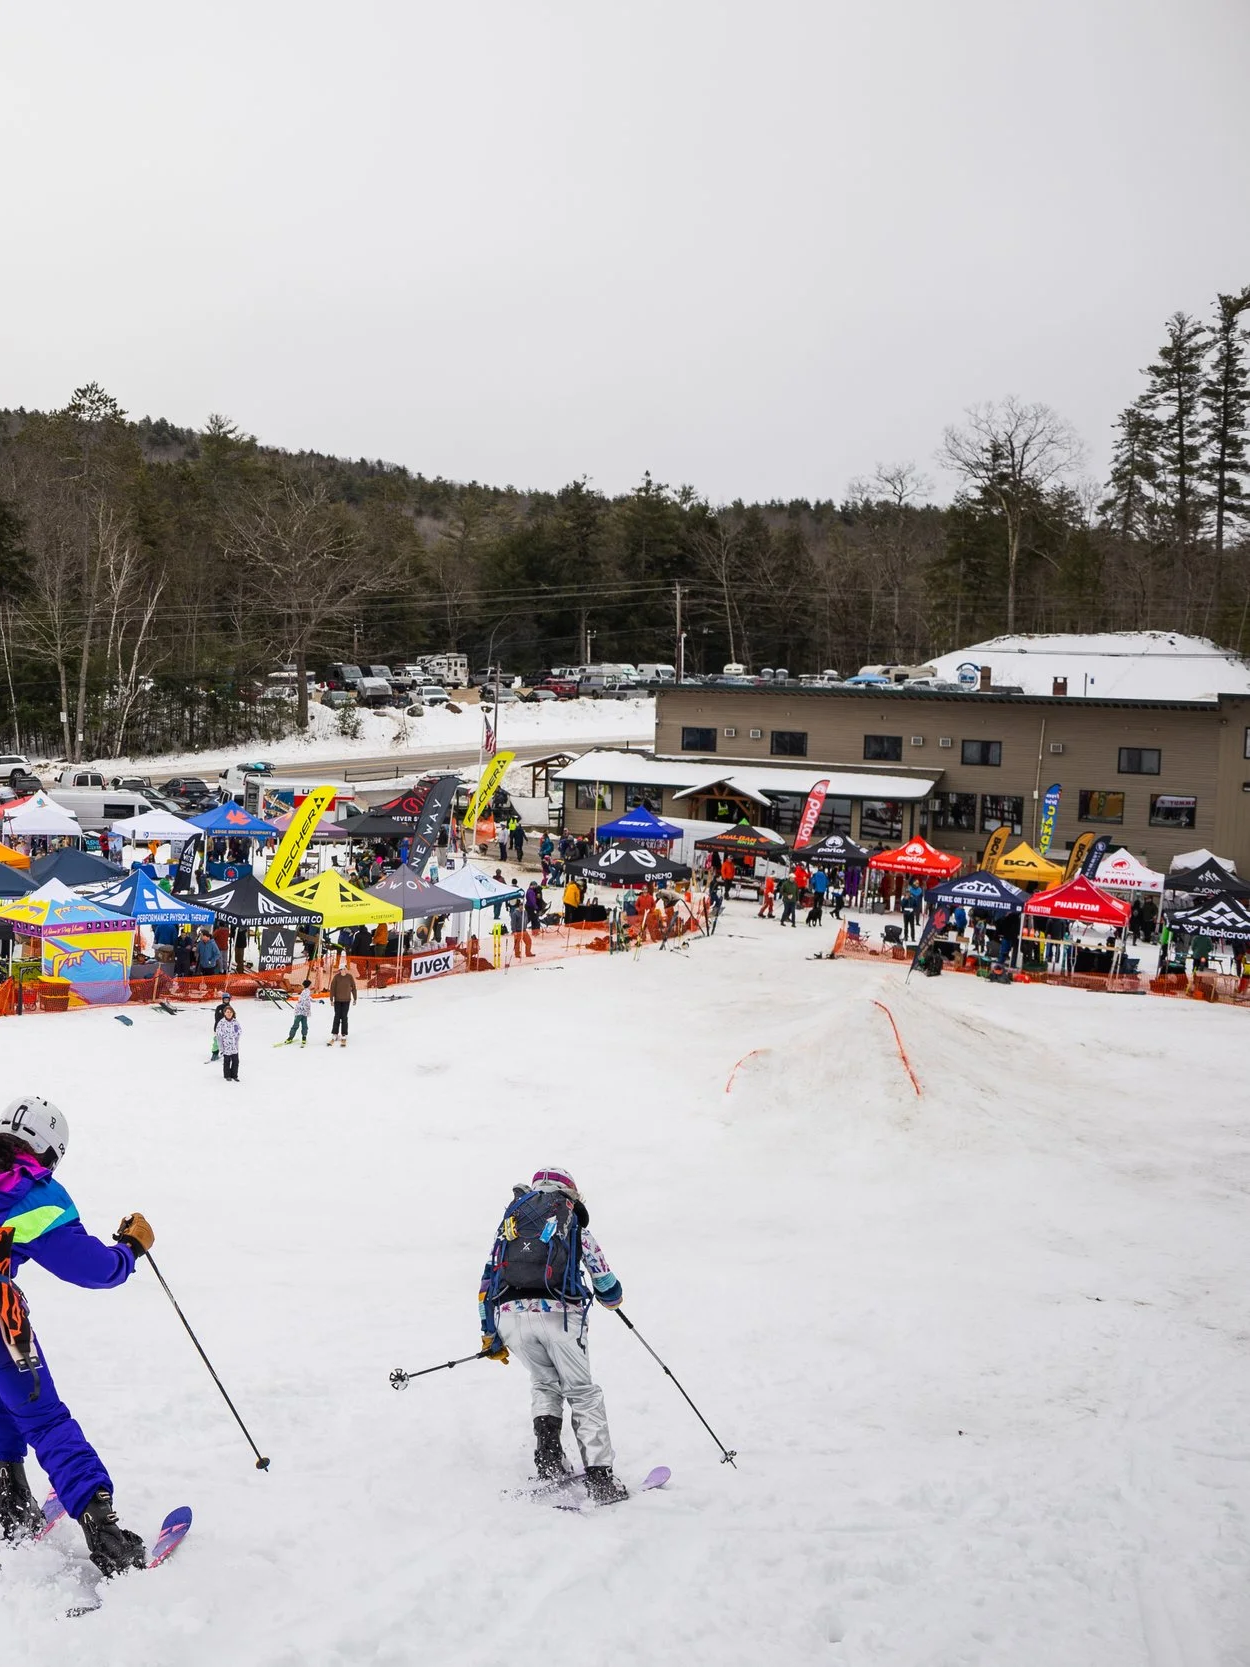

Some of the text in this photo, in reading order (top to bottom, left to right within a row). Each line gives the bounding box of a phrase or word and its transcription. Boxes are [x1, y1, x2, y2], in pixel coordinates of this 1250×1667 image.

[800, 797, 821, 842] parlor
[275, 810, 317, 889] FISCHER
[1004, 860, 1038, 868] BCA
[588, 871, 606, 879] NEMO
[652, 872, 673, 880] NEMO
[1092, 877, 1143, 887] MAMMUT
[1199, 887, 1226, 895] JONE
[977, 899, 1011, 910] MOUNTAIN
[1027, 905, 1052, 914] PHANTOM
[1054, 901, 1101, 912] PHANTOM
[137, 913, 210, 923] PERFORMANCE PHYSICAL THERAPY
[227, 916, 238, 925] CO
[241, 915, 322, 926] WHITE MOUNTAIN SKI CO
[1199, 926, 1250, 940] blackcrow
[268, 947, 287, 955] WHITE
[265, 963, 276, 971] SKI
[413, 956, 450, 976] uvex
